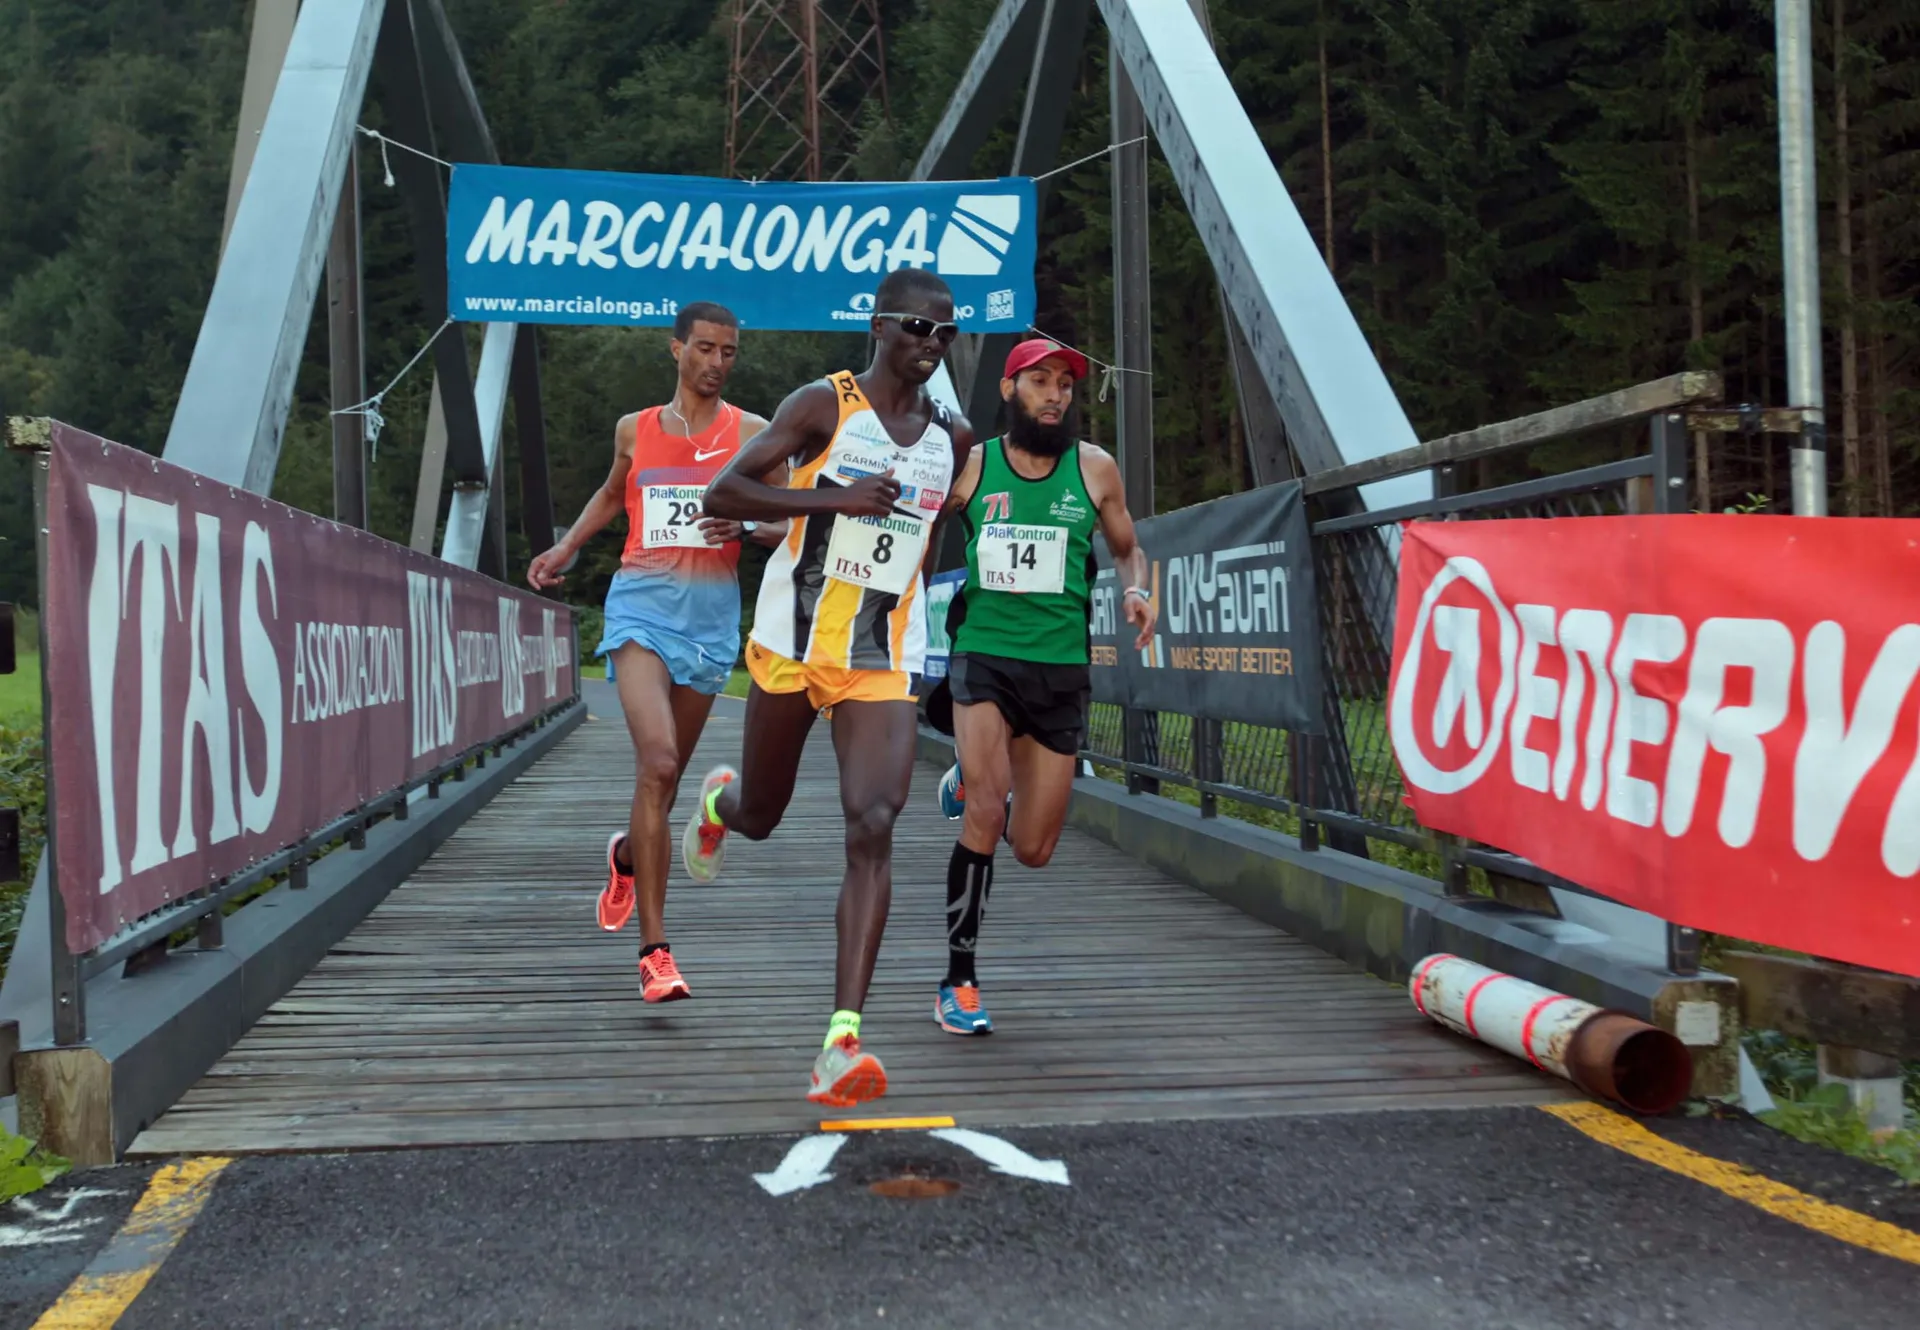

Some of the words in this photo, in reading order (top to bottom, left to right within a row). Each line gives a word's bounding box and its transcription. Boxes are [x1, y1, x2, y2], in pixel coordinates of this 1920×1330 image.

[466, 195, 936, 274] MARCIALONGA
[465, 295, 678, 319] www.marcialonga.it
[843, 453, 889, 470] GARMIN
[667, 501, 698, 527] 29
[650, 528, 678, 542] ITAS
[872, 533, 894, 564] 8
[1006, 542, 1037, 570] 14
[836, 557, 872, 579] ITAS
[986, 570, 1016, 585] ITAS
[1170, 647, 1201, 669] MAKE
[1203, 647, 1239, 671] SPORT
[1240, 647, 1293, 676] BETTER
[87, 483, 284, 896] ITAS
[407, 570, 458, 758] ITAS
